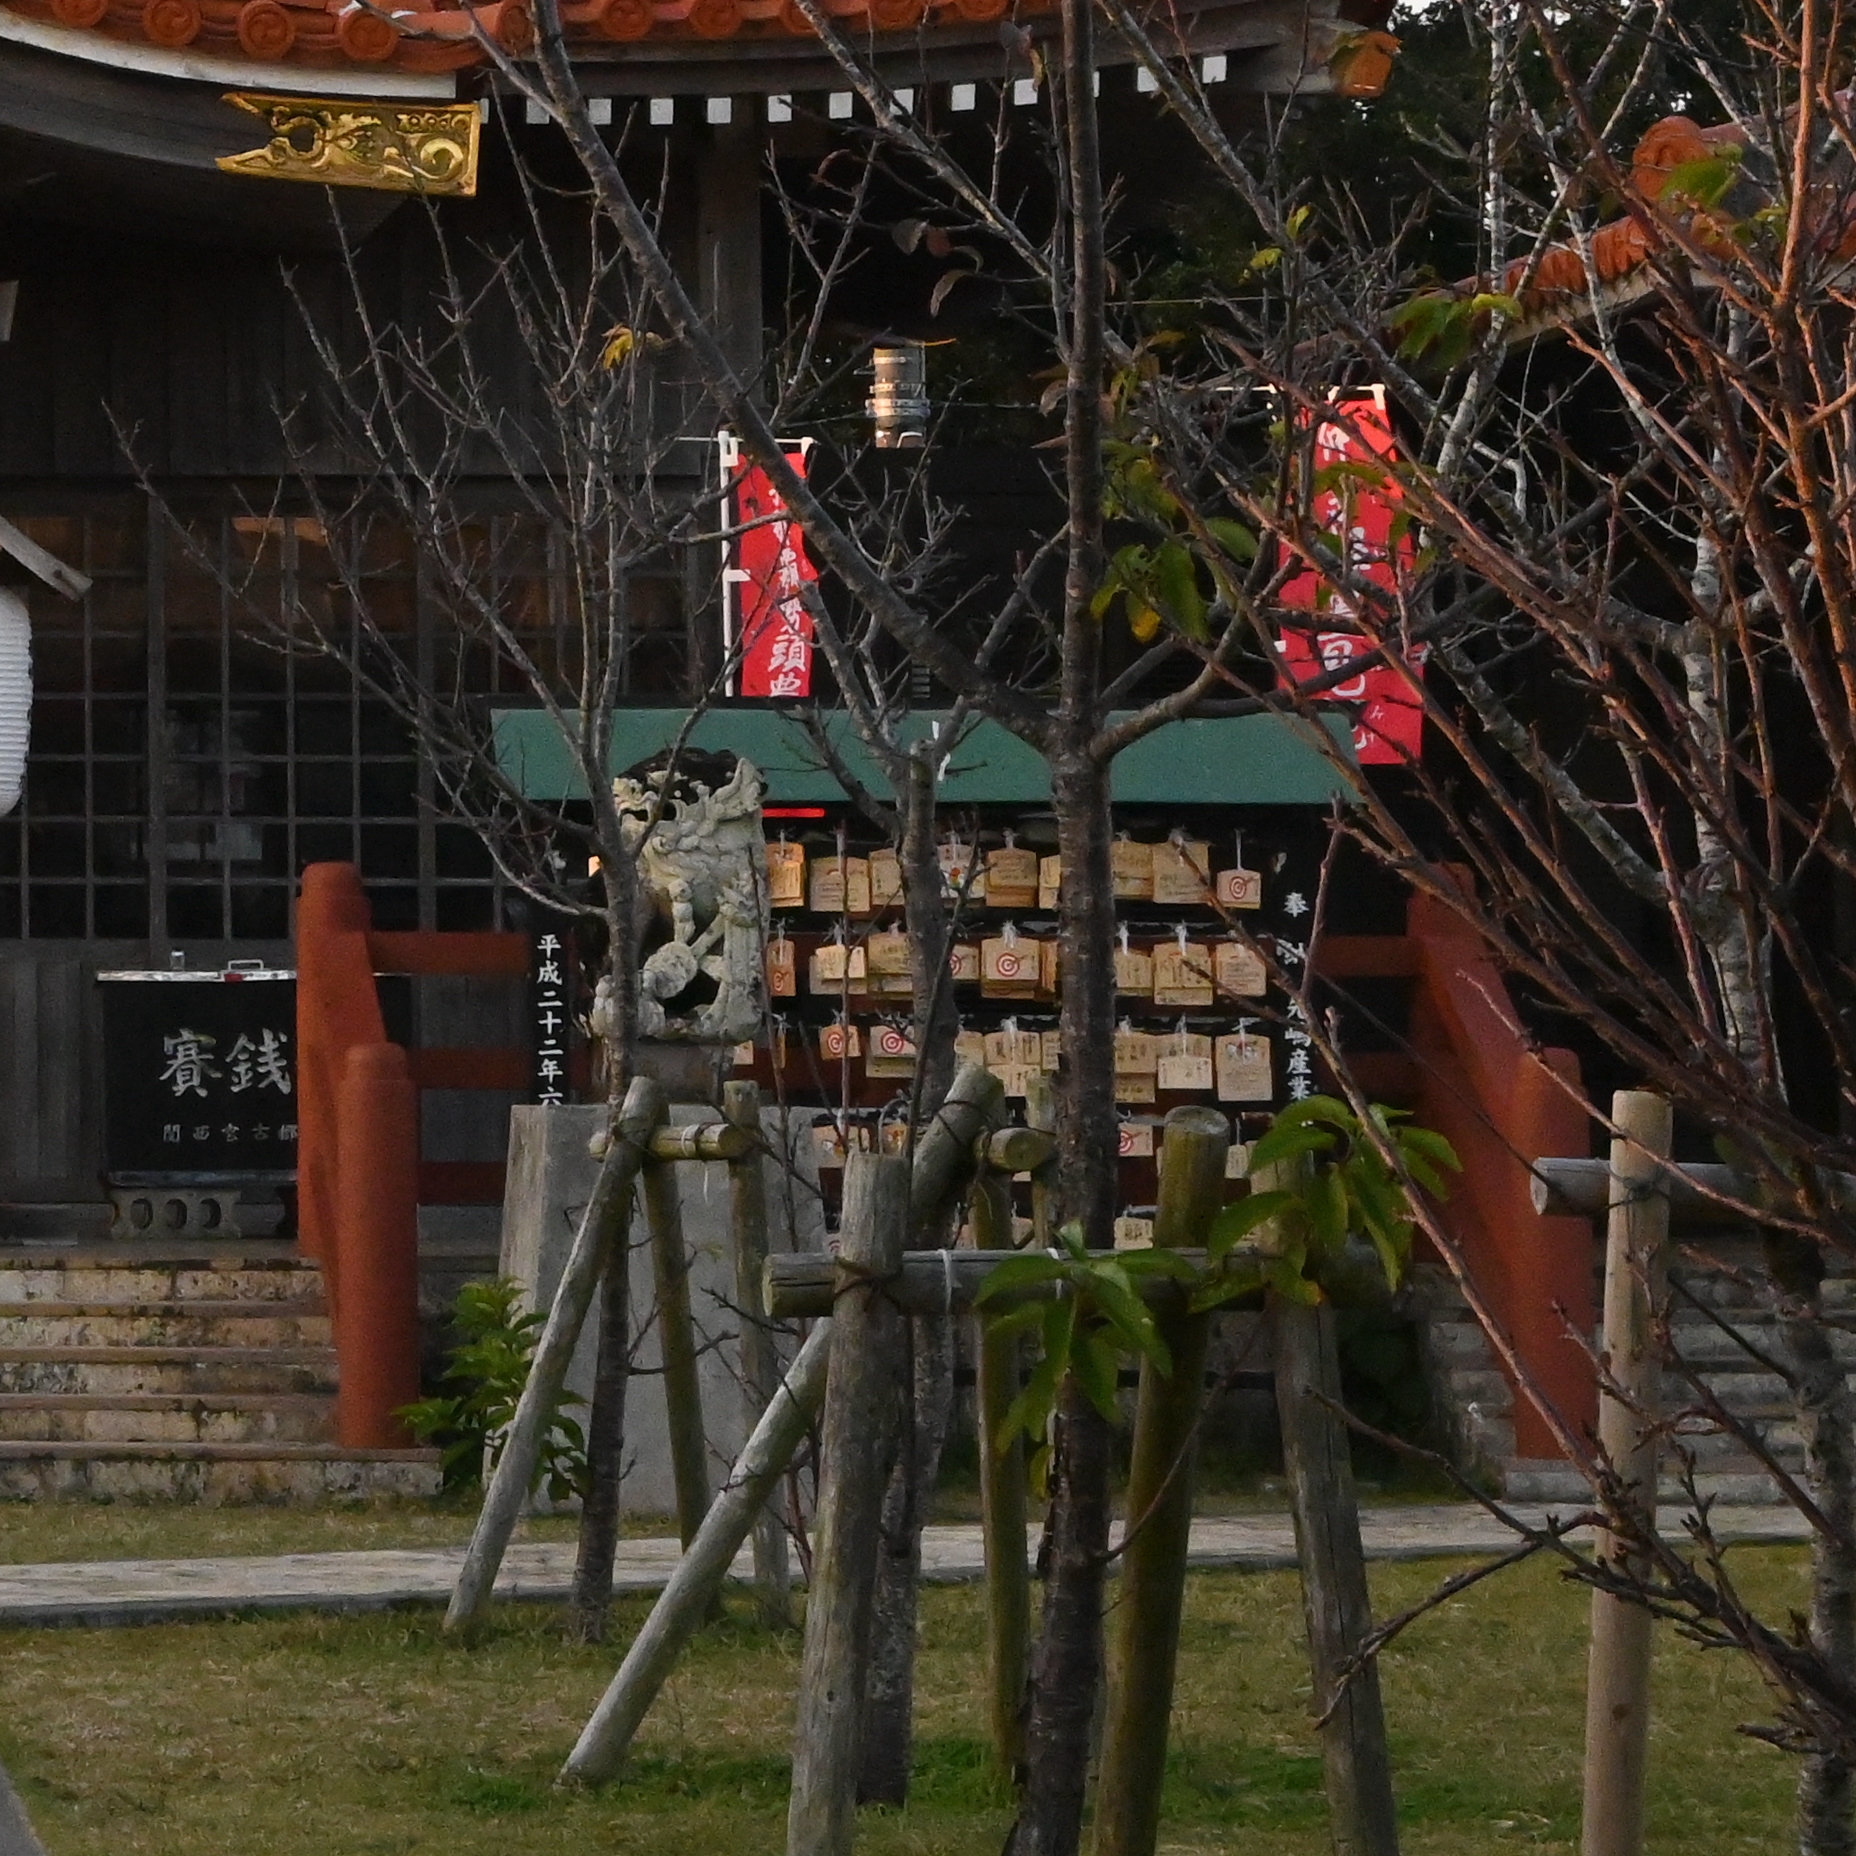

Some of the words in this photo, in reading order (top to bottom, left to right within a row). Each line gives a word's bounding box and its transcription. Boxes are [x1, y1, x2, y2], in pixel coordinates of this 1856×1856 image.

[159, 1027, 292, 1098] 賽銭
[536, 934, 564, 1106] 平成二十二年六
